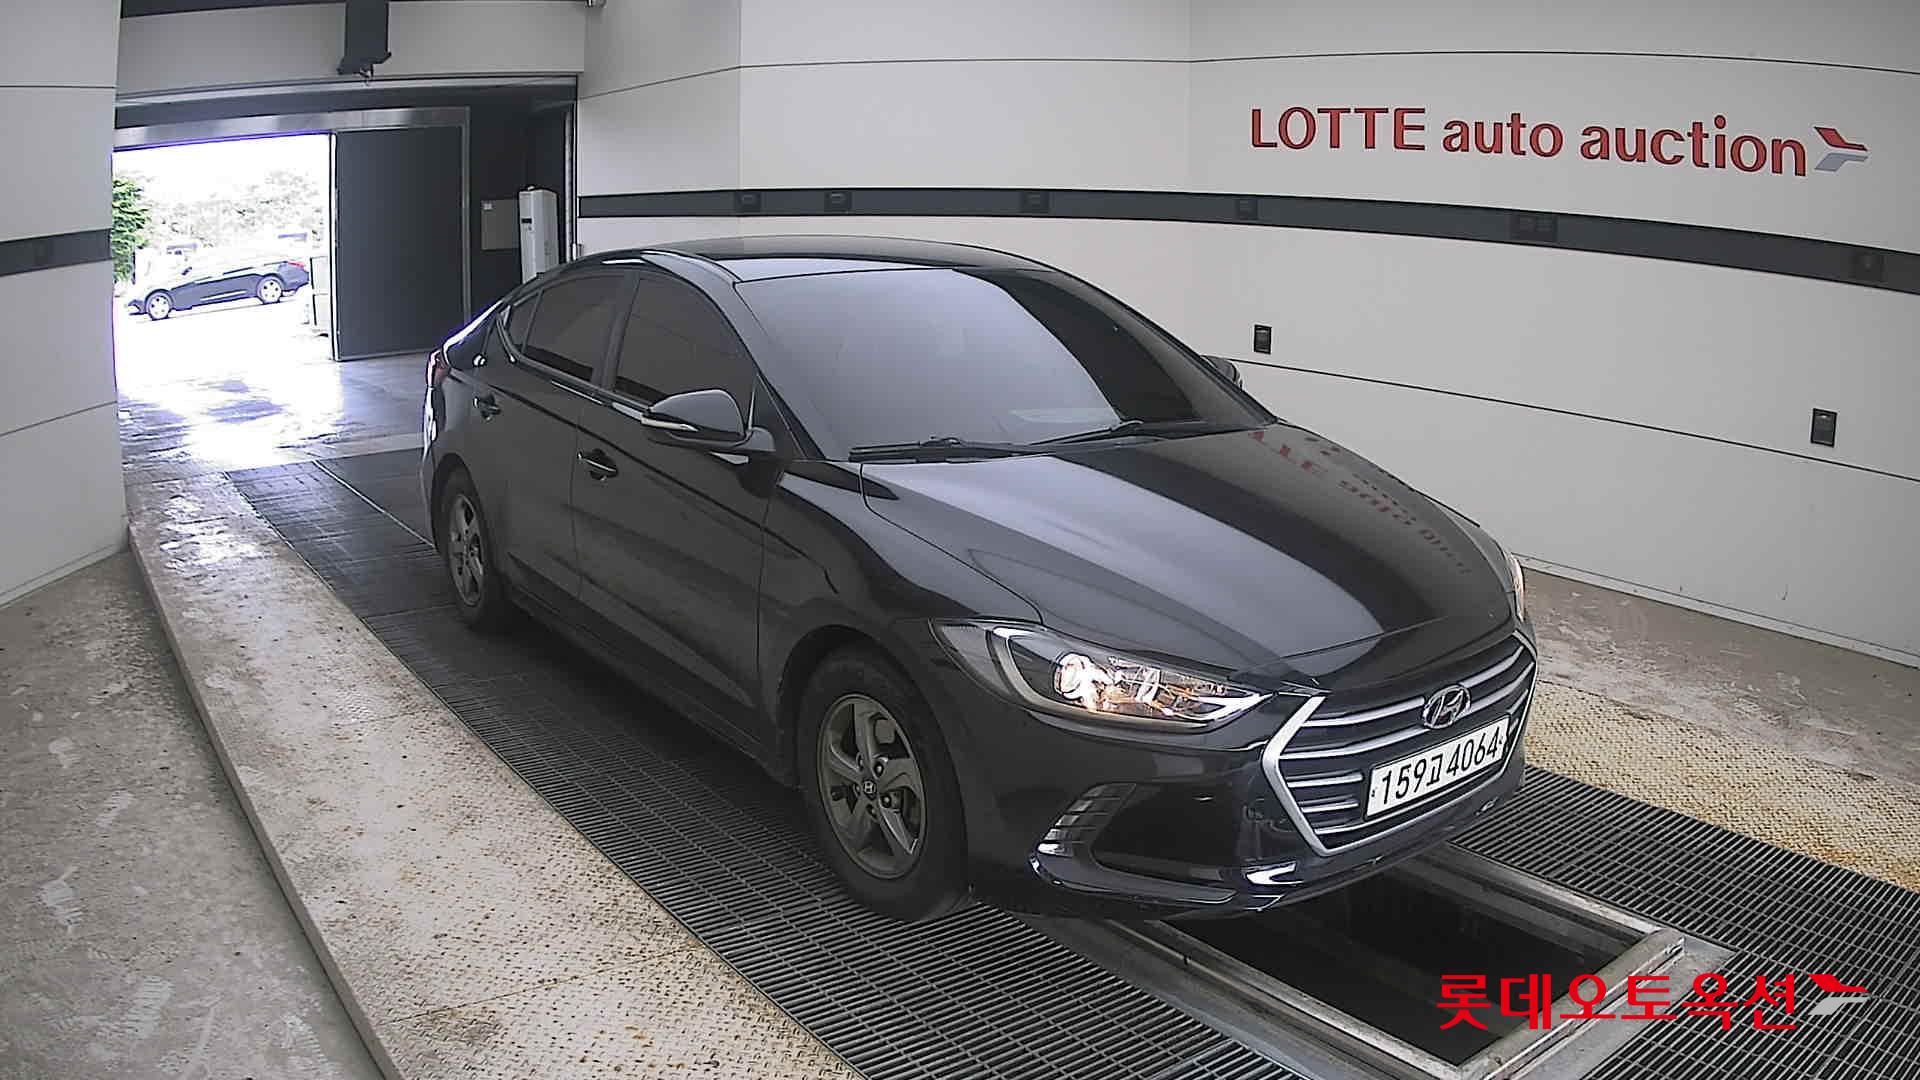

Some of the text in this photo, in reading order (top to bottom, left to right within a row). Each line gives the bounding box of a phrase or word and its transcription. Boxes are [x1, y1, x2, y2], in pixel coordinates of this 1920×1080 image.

[1251, 107, 1807, 176] LOTTE auto auction
